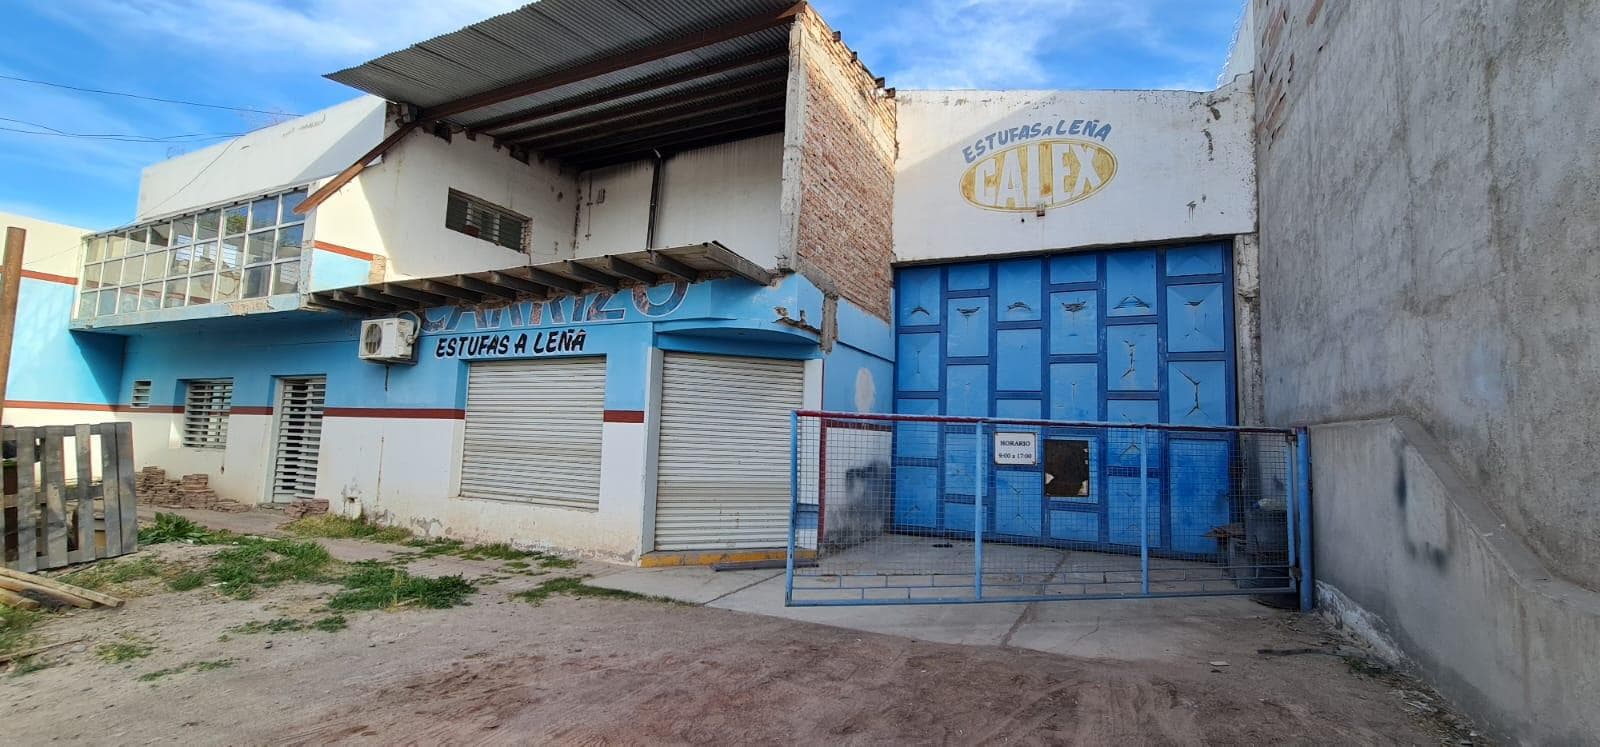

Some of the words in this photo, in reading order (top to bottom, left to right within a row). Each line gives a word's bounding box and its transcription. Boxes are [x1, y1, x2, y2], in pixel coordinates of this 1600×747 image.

[962, 122, 1042, 164] ESTUFAS
[1042, 125, 1053, 137] A
[1055, 119, 1112, 142] LEÑA
[975, 143, 1102, 208] CALEX
[436, 334, 510, 358] ESTUFAS
[514, 333, 528, 354] A
[533, 328, 587, 354] LEÑA
